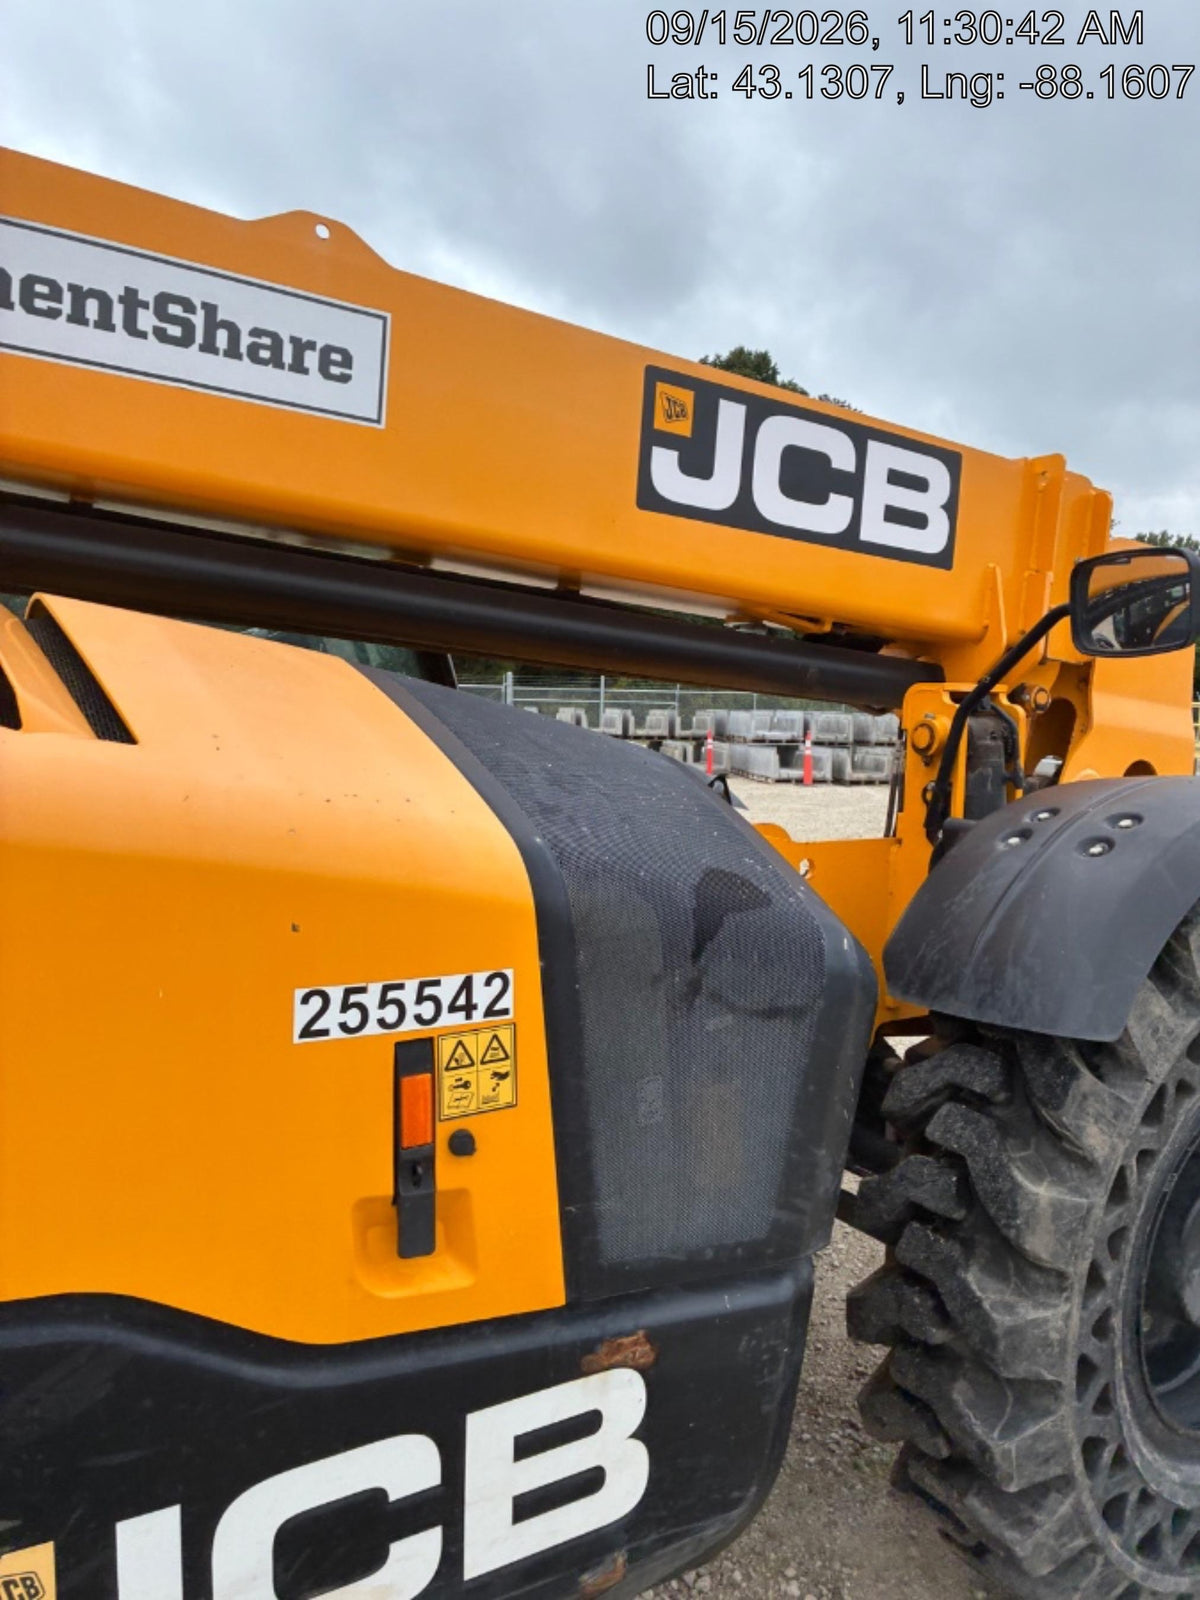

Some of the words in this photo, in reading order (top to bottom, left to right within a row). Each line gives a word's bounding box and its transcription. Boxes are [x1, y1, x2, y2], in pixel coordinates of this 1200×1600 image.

[650, 397, 951, 555] JCB
[297, 971, 511, 1040] 255542
[0, 1576, 41, 1600] CB
